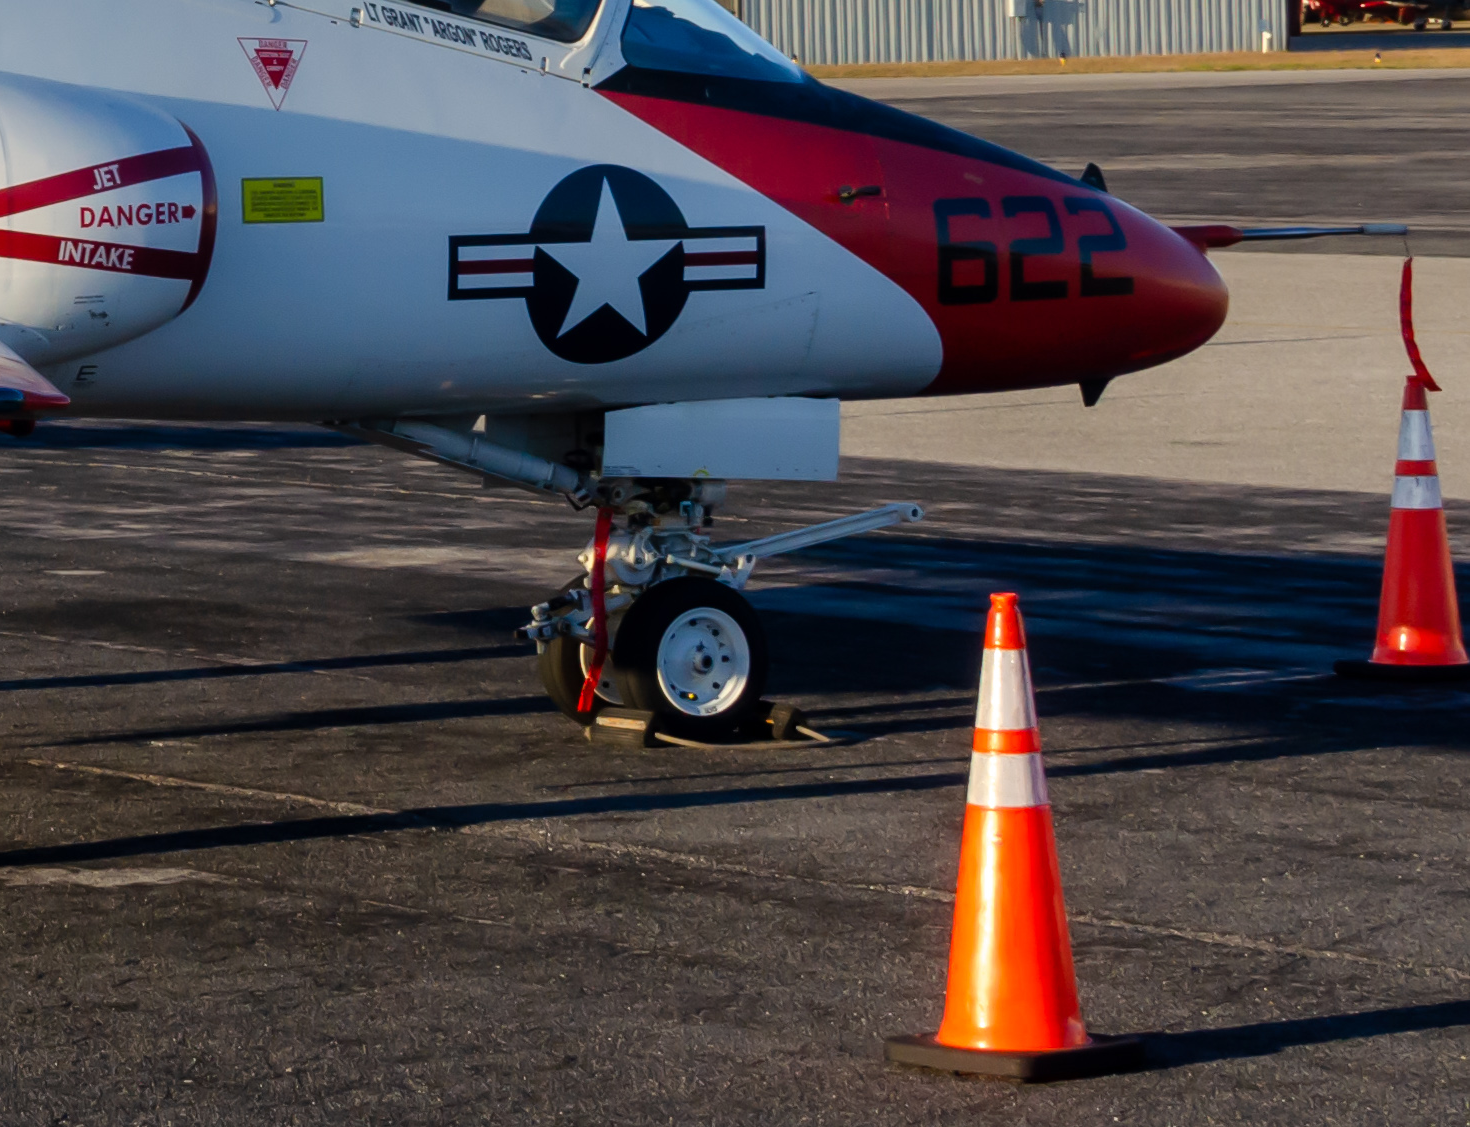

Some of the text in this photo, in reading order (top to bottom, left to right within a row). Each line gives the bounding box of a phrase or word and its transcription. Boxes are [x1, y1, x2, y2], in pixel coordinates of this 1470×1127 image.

[363, 1, 382, 23] LT
[381, 5, 425, 34] GRANT
[479, 30, 533, 61] ROGERS
[93, 164, 121, 190] JET
[80, 202, 180, 229] DANGER
[58, 240, 135, 269] INTAKE
[932, 195, 1134, 306] 622
